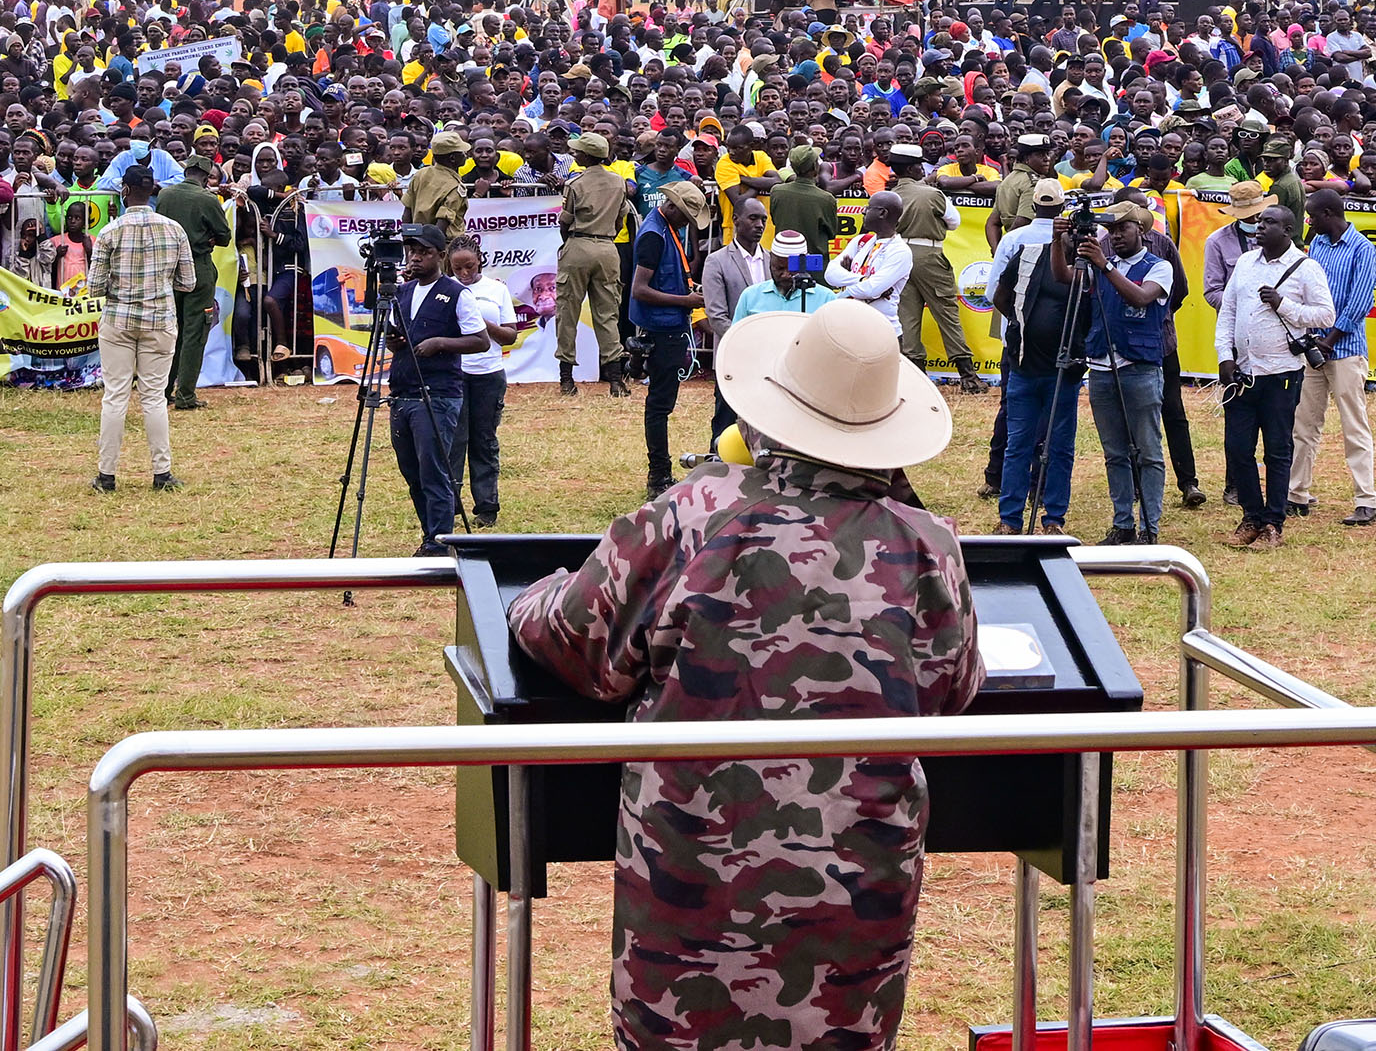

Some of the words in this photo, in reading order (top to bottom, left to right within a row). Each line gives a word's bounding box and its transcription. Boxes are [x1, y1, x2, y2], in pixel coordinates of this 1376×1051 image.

[643, 191, 667, 202] Emira
[955, 196, 993, 207] CREDIT
[1201, 193, 1231, 203] NKOM
[492, 249, 536, 265] PARK
[26, 289, 59, 306] THE
[434, 293, 451, 303] PPU
[54, 346, 86, 356] YOWERI
